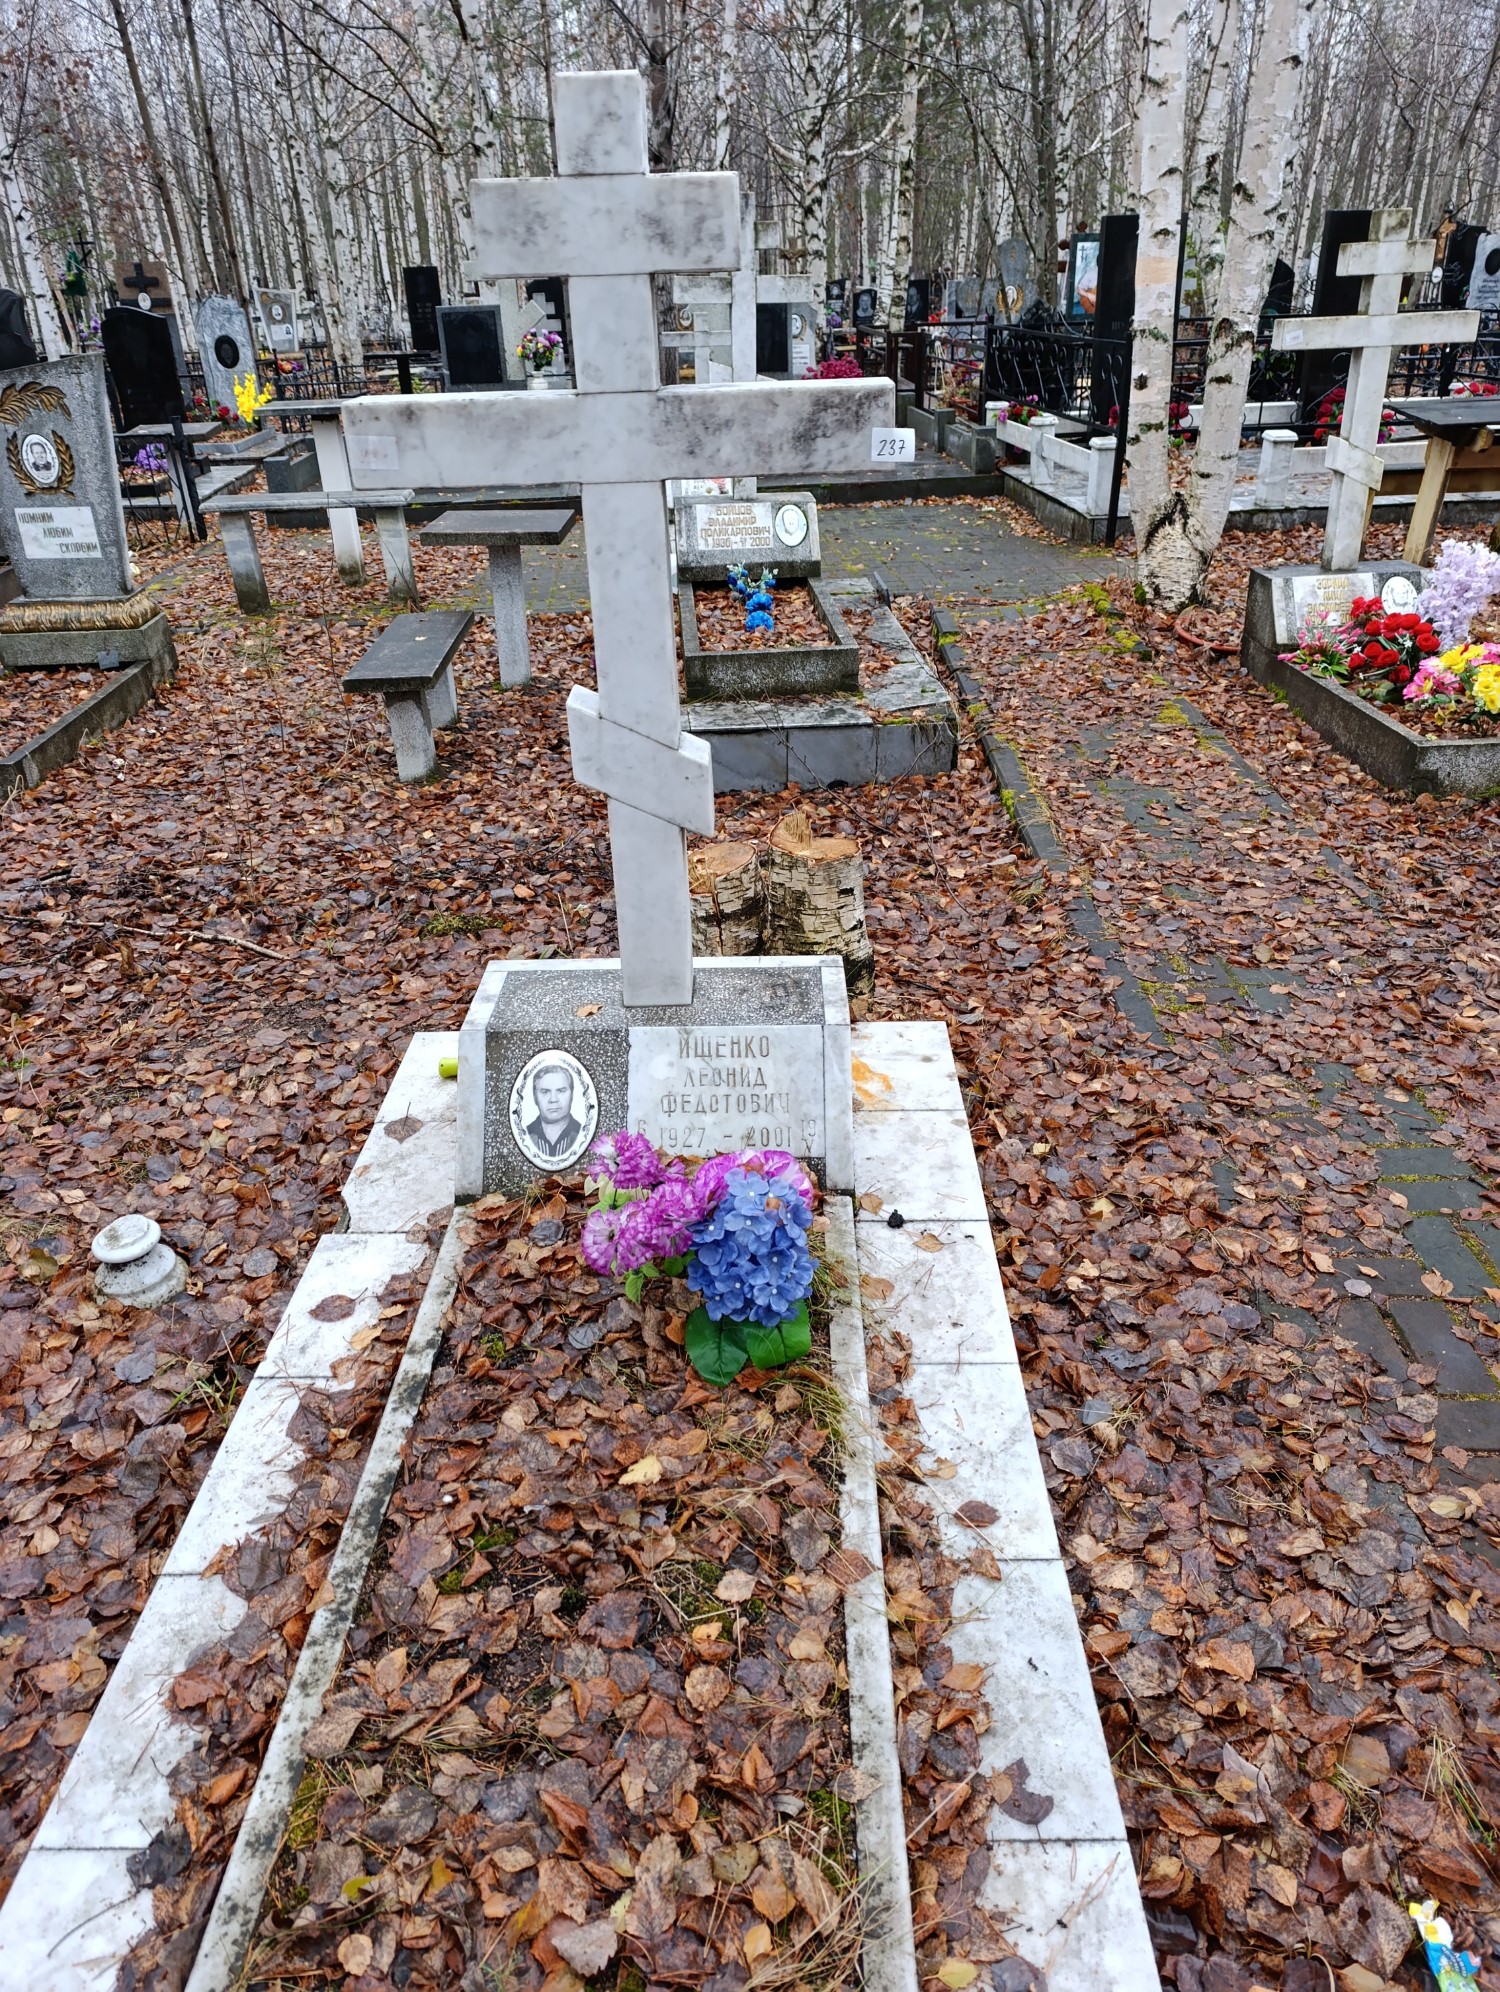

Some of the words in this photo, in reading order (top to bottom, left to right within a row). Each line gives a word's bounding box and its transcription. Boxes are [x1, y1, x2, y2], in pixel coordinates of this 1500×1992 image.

[877, 439, 906, 456] 237
[716, 504, 752, 516] БОЙЦОВ
[18, 512, 54, 523] ПОМНИМ
[708, 516, 757, 527] ВЛАДИМИР
[43, 527, 73, 538] ЛЮБИМ
[700, 526, 771, 538] ПОЛИКАРПОВИЧ
[60, 542, 99, 553] СКОРБИМ
[750, 536, 771, 547] 2000
[679, 1035, 770, 1061] ИЩЕНКО
[684, 1067, 767, 1089] ЛЕОНИД
[661, 1092, 790, 1117] ФЕДОТОВИЧ
[660, 1127, 706, 1148] 1927
[746, 1126, 792, 1147] 2001
